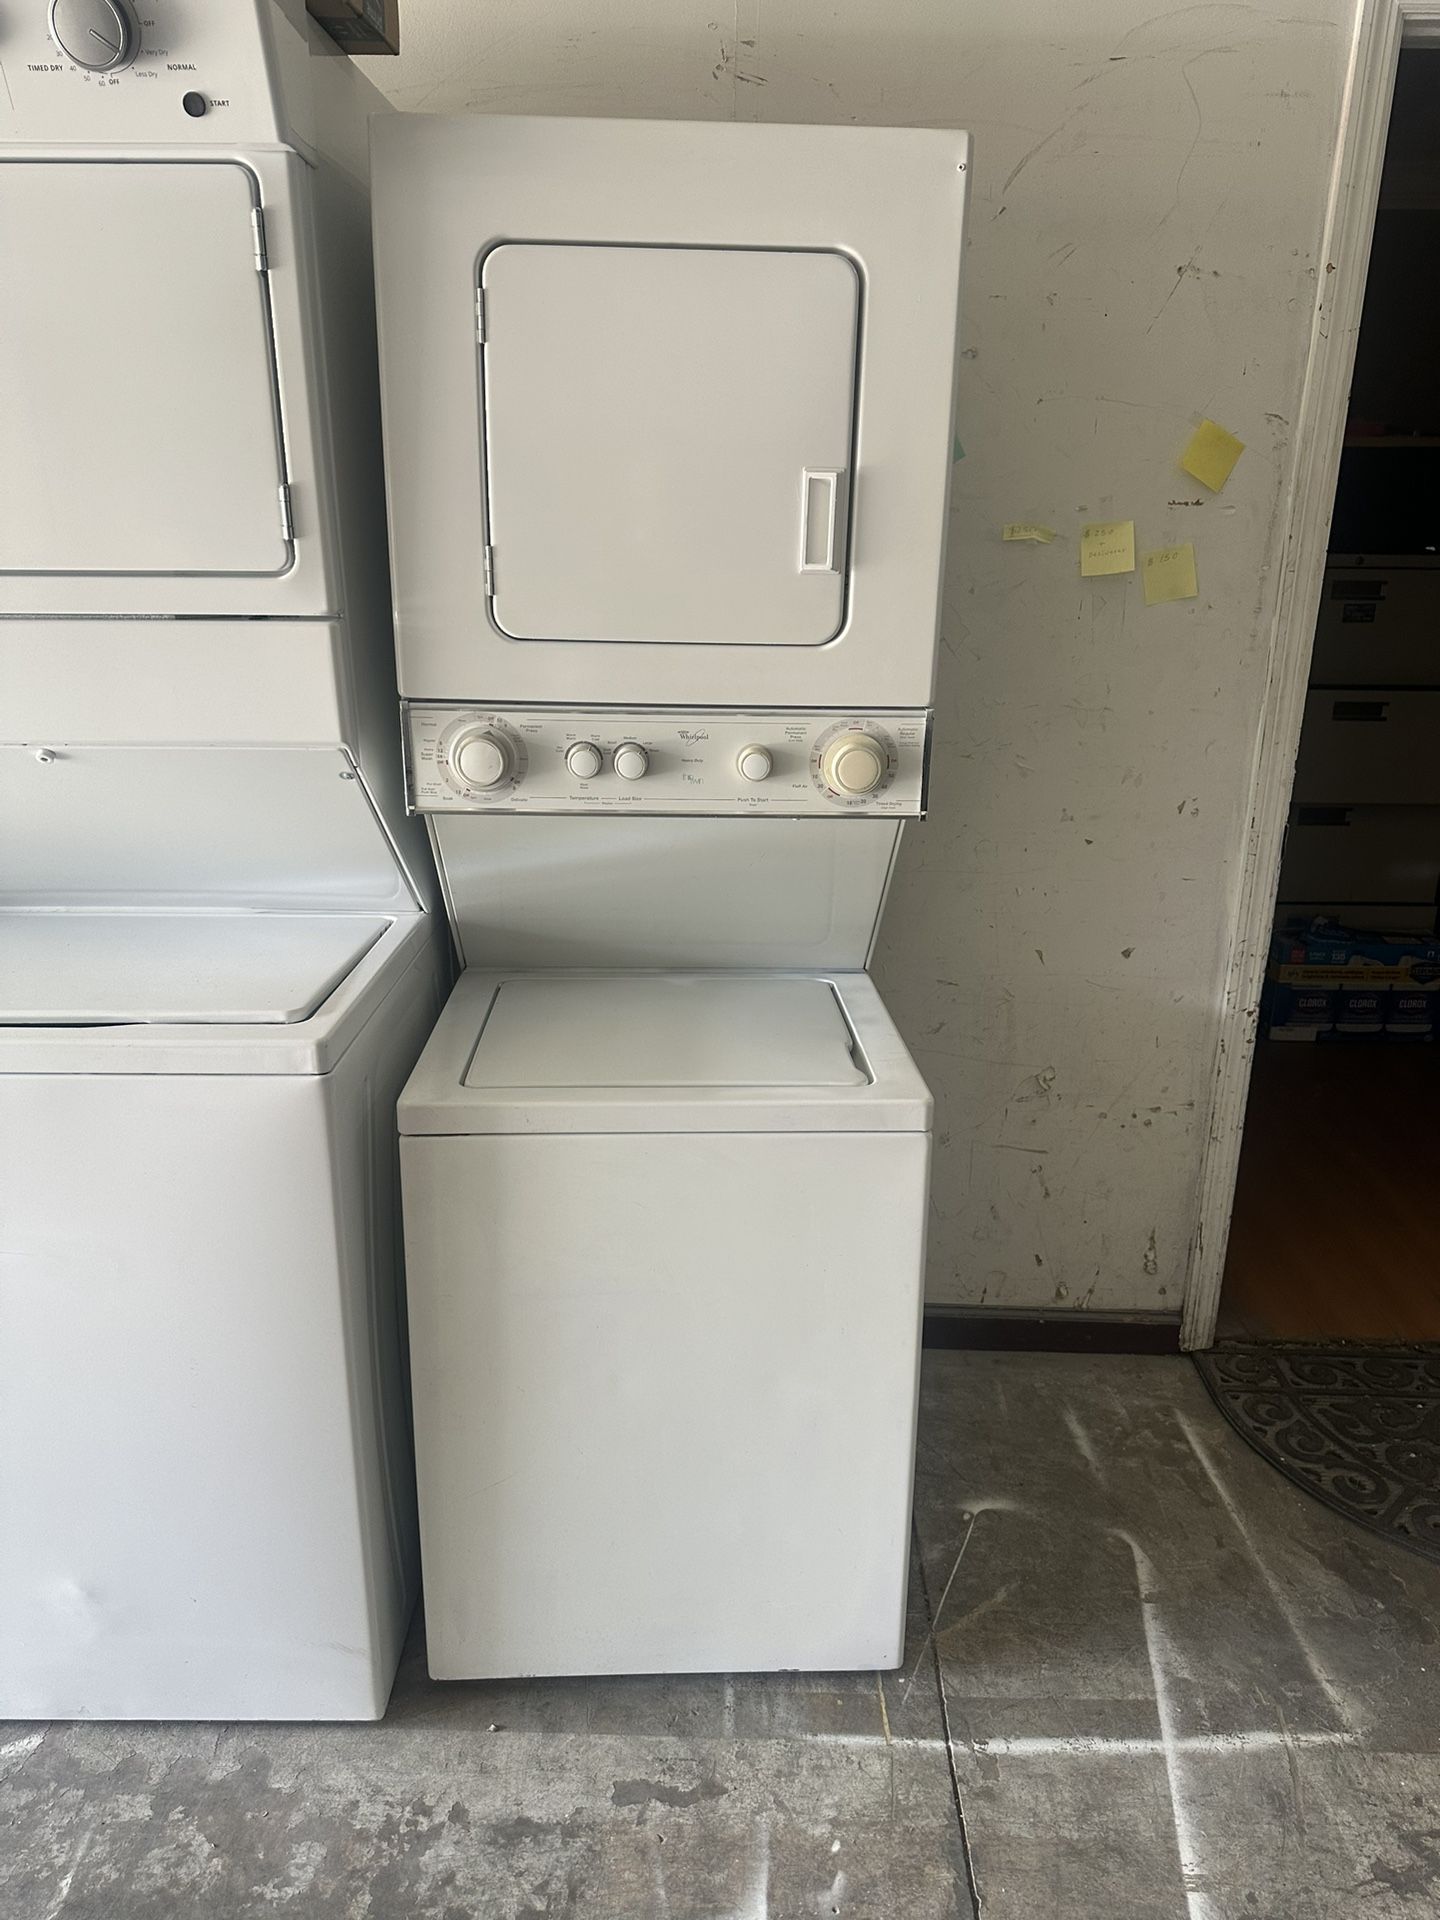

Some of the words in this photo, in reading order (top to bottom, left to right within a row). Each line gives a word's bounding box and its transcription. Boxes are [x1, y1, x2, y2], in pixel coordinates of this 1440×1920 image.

[27, 64, 49, 72] TIMED
[148, 71, 159, 79] Dry
[680, 732, 709, 741] Whirlpool
[1299, 998, 1327, 1009] CLOROX
[1349, 998, 1377, 1009] CLOROX
[1399, 998, 1427, 1009] CLOROX
